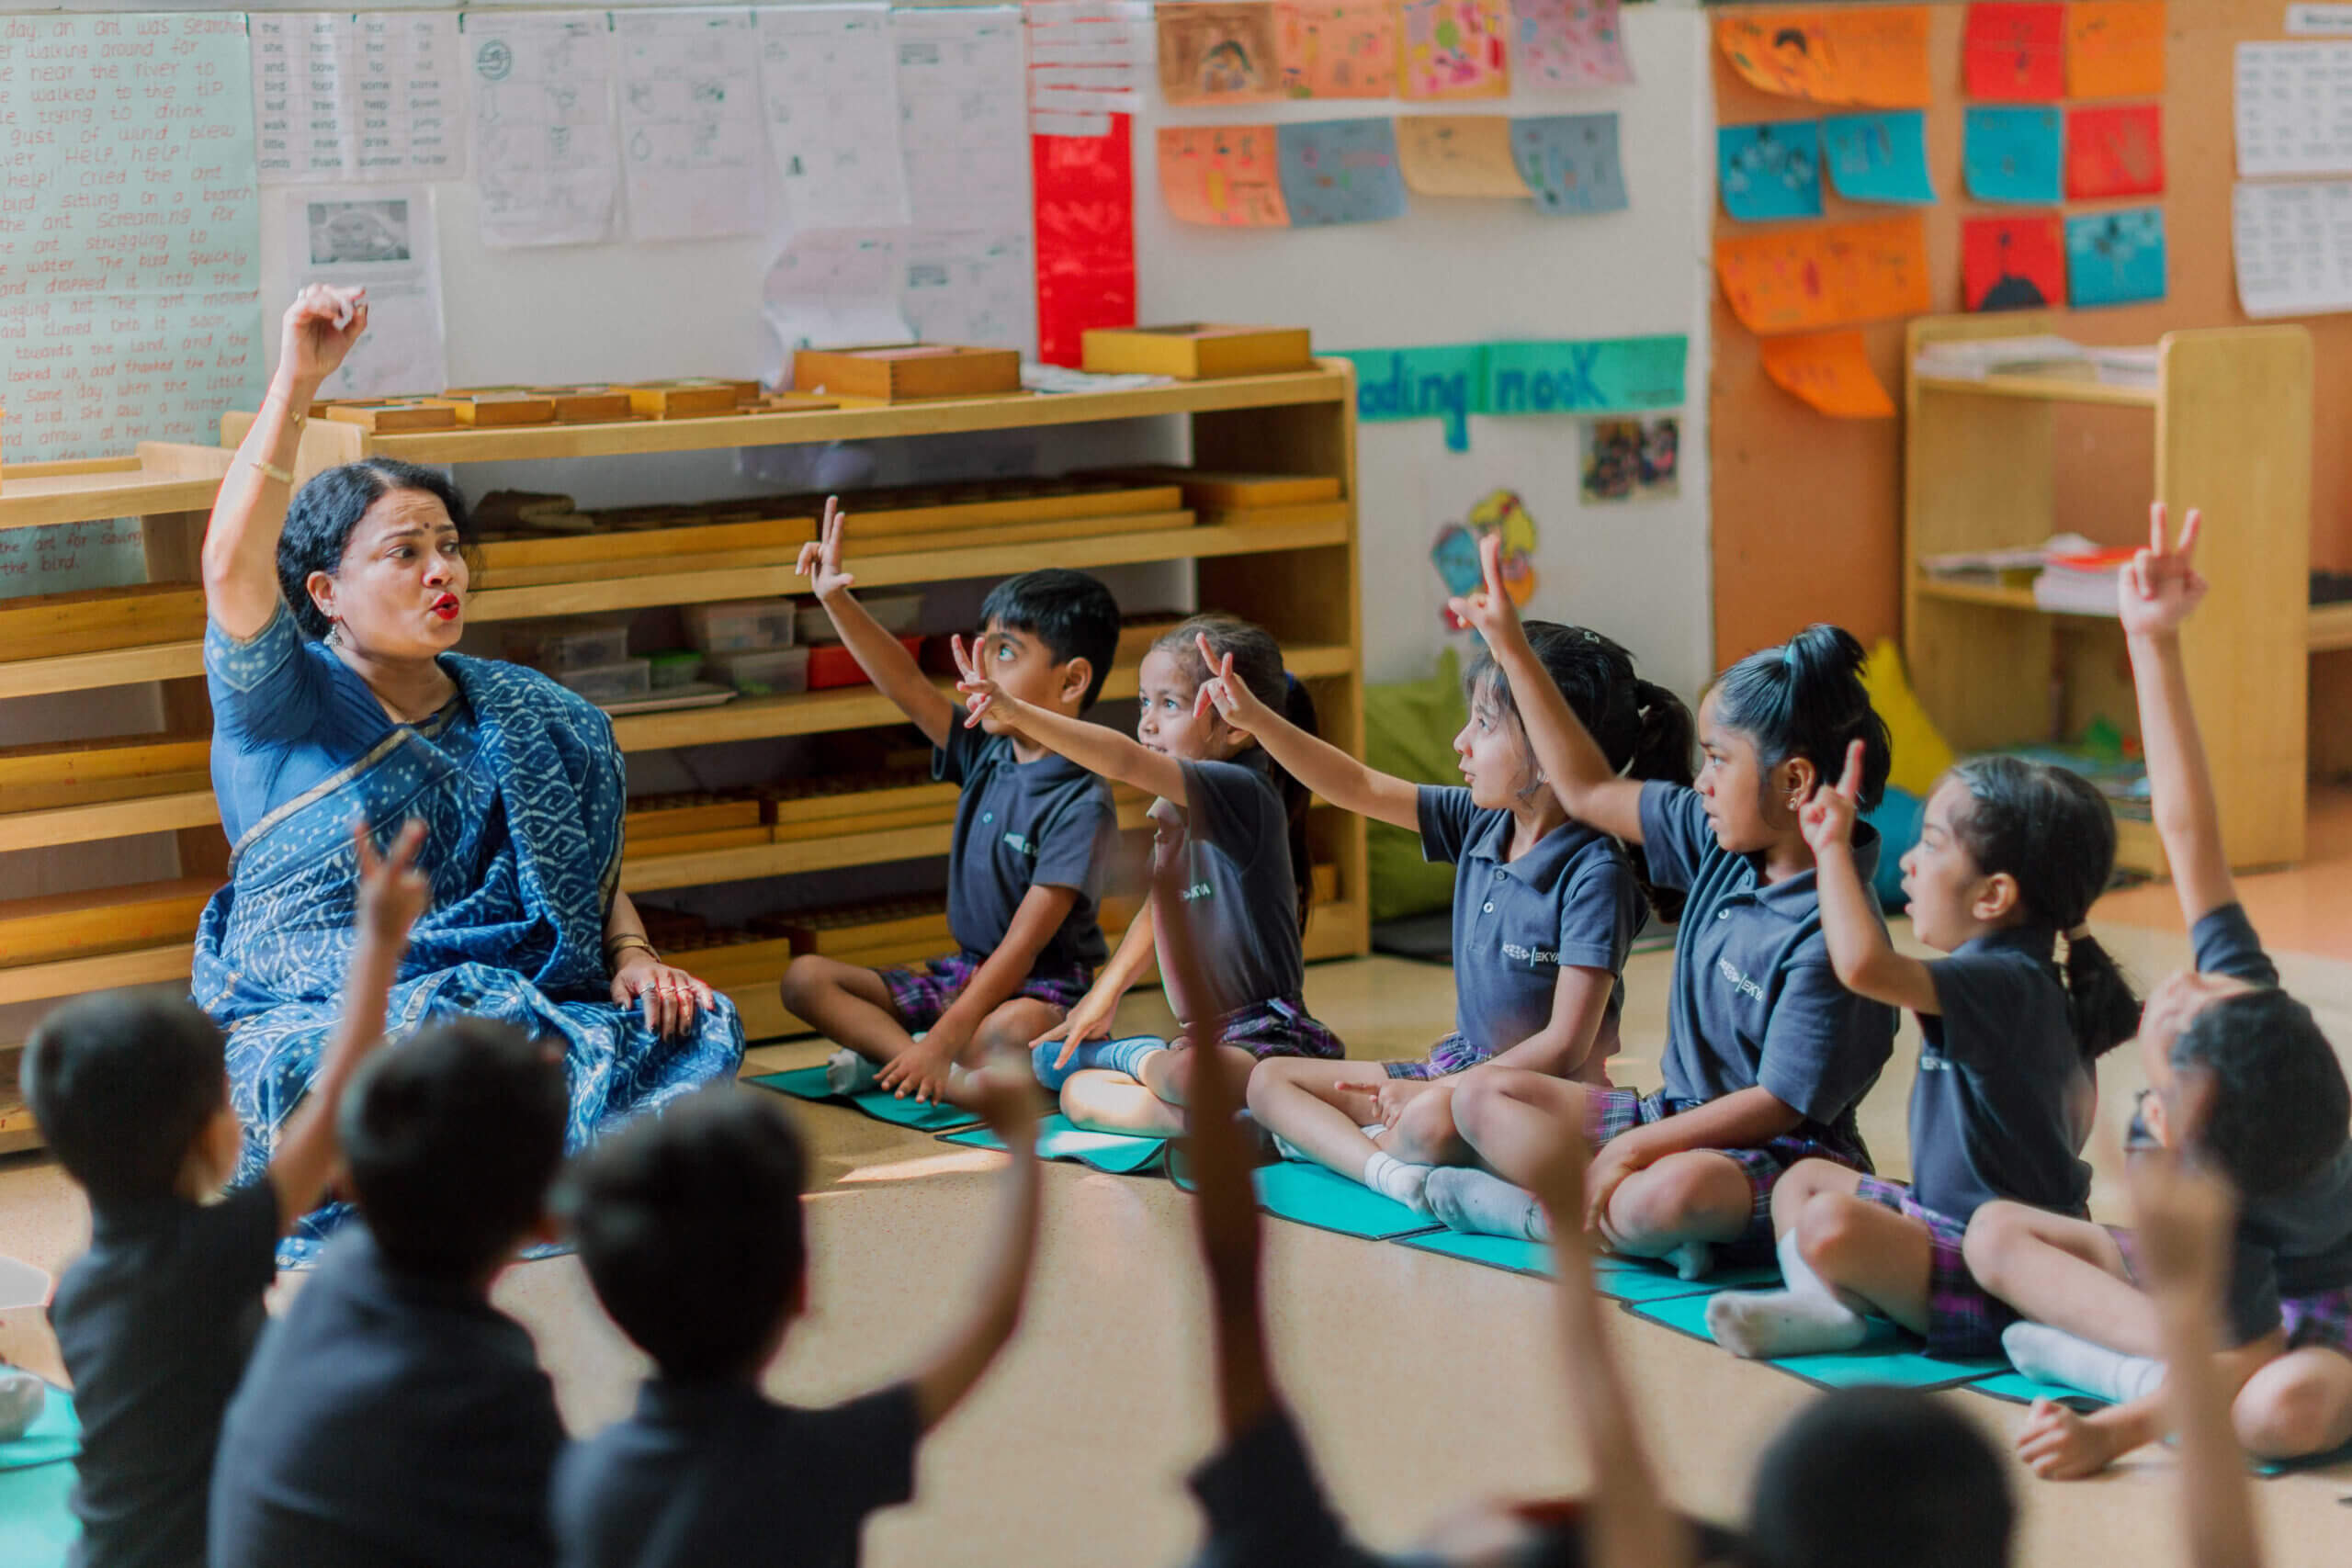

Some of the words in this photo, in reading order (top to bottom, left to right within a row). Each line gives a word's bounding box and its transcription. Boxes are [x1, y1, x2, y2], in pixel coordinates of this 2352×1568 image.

[89, 63, 119, 80] the
[42, 214, 74, 231] ant
[33, 235, 60, 254] ant
